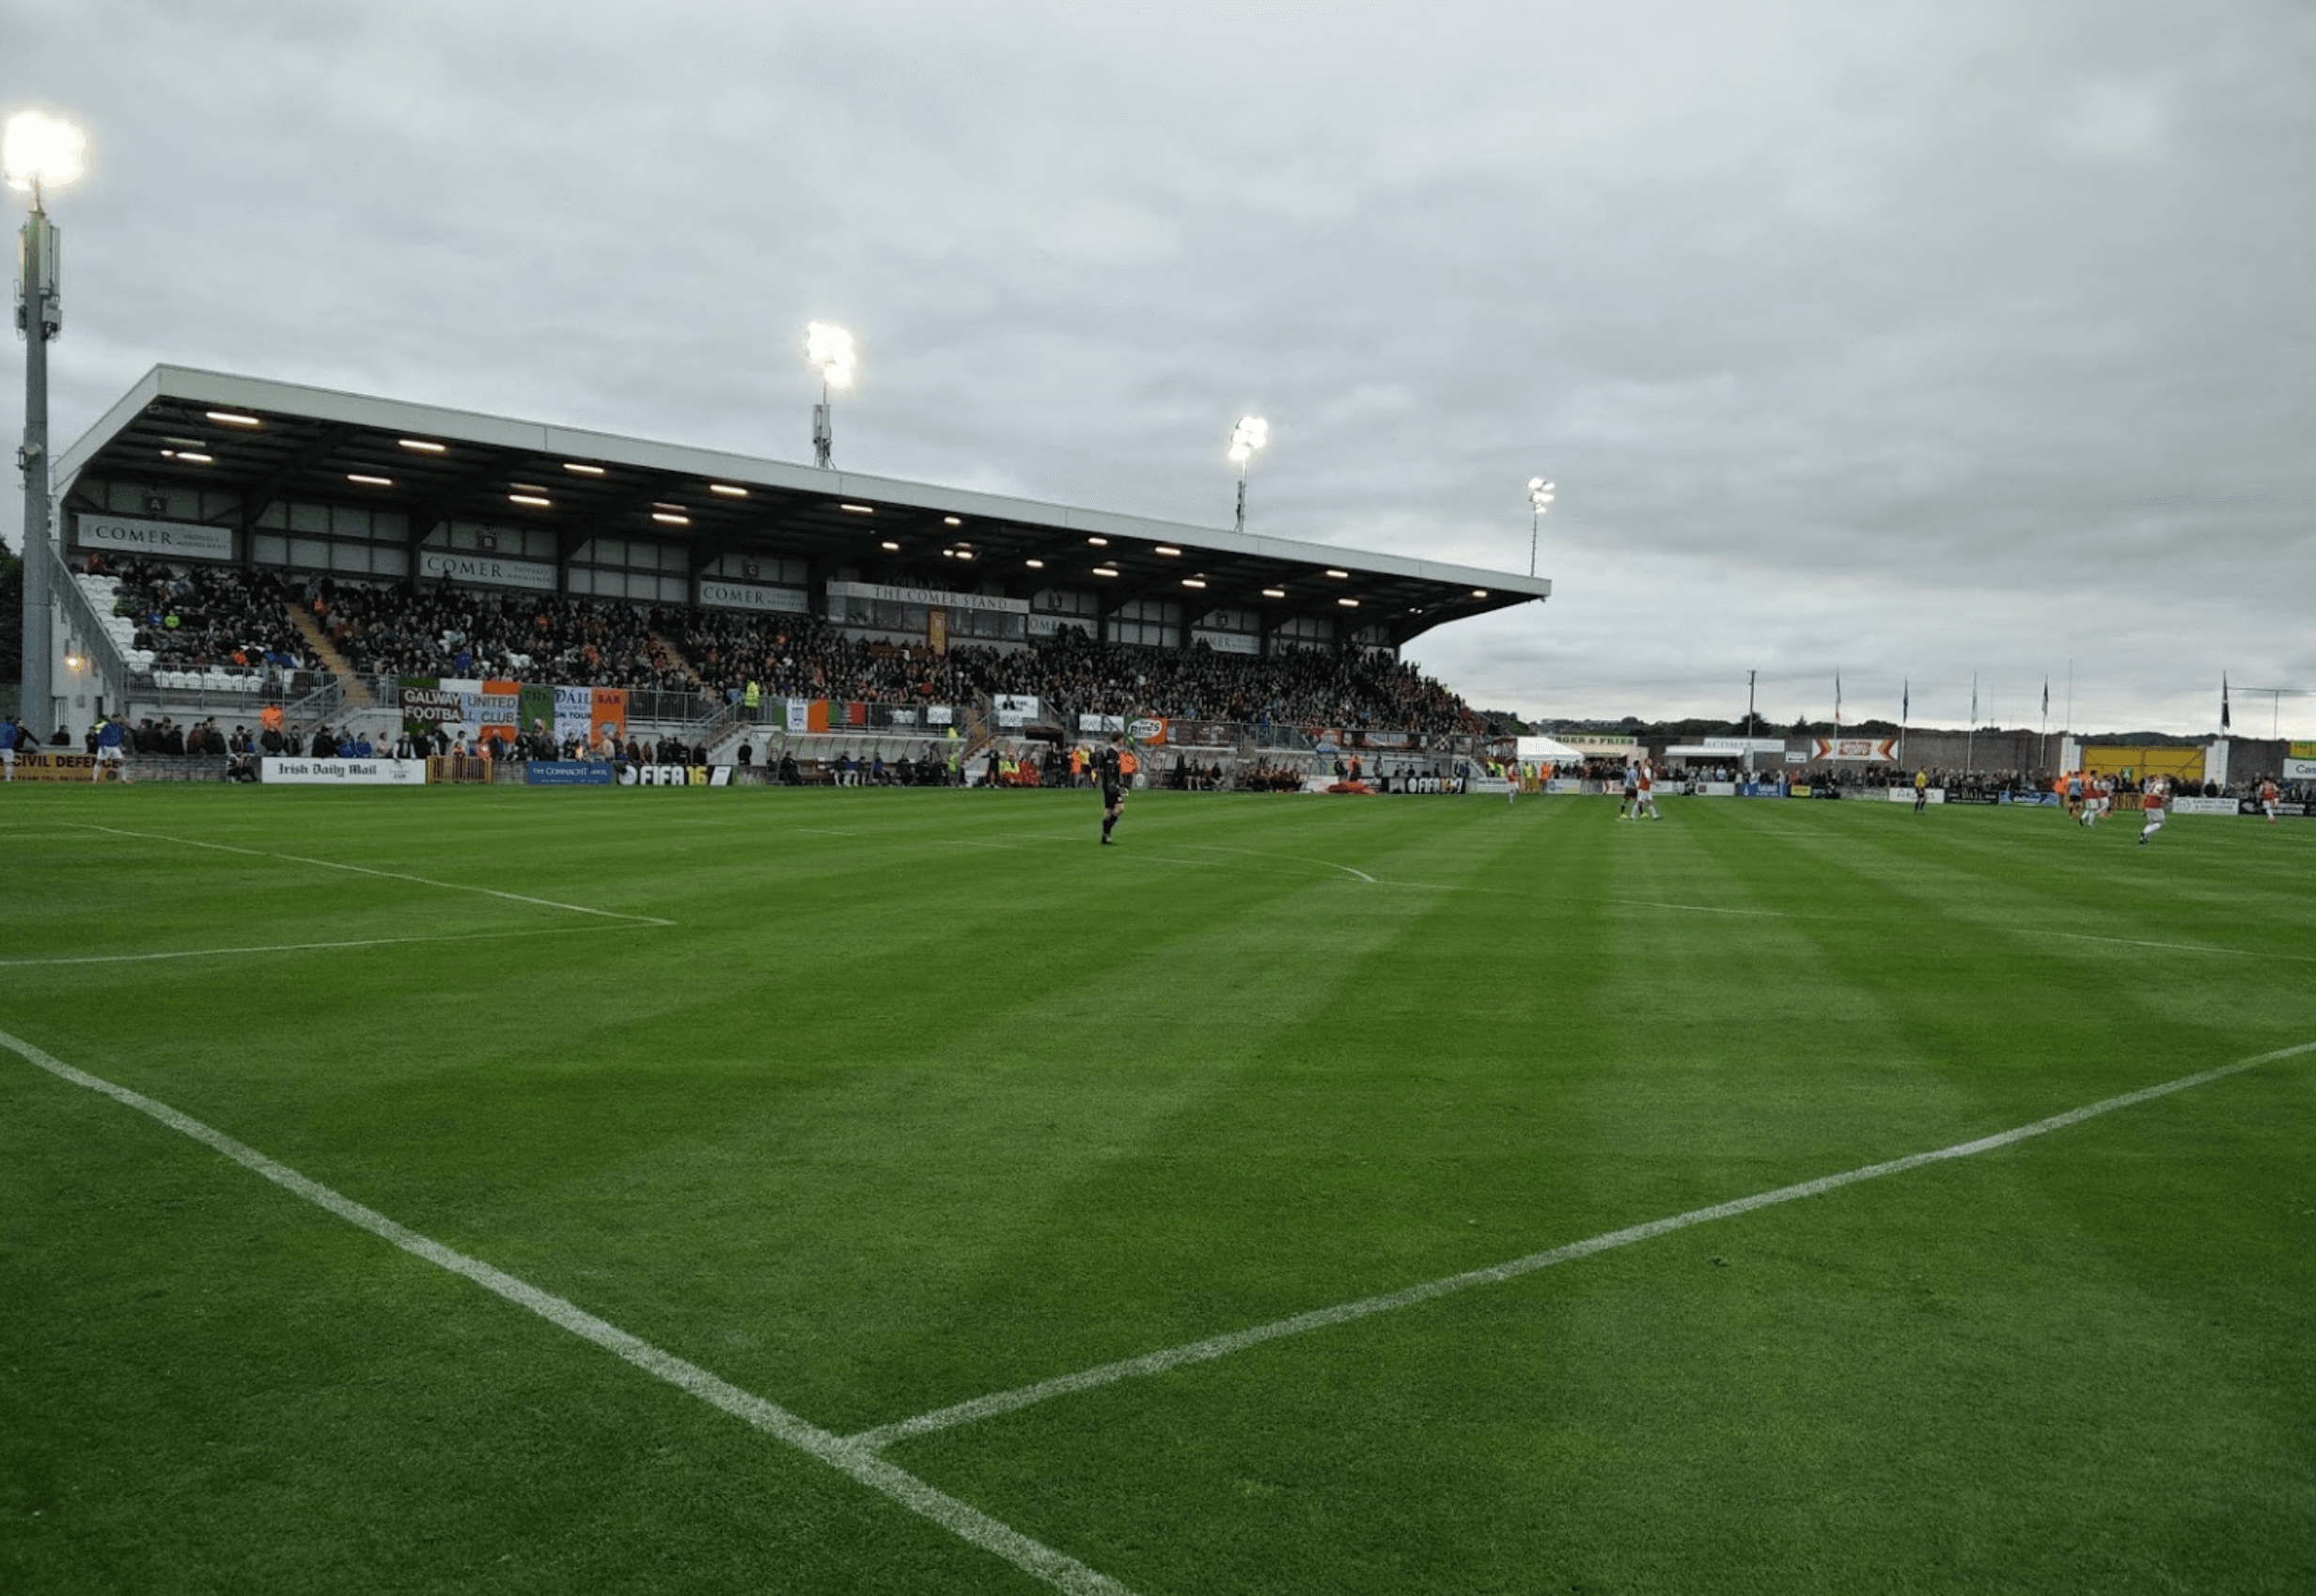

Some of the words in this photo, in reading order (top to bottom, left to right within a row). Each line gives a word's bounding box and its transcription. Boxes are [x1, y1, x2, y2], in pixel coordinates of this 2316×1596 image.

[96, 525, 172, 545] COMER
[427, 556, 503, 578] COMER
[703, 587, 765, 604] COMER
[874, 587, 901, 599] THE
[907, 589, 958, 605] COMER
[963, 595, 1007, 609] STAND
[404, 690, 461, 706] GALWAY
[467, 694, 516, 709] UNITED
[598, 694, 620, 704] BAR
[404, 706, 477, 723] FOOTBALL
[480, 711, 515, 723] CLUB
[12, 756, 52, 767] CIVIL
[278, 763, 308, 775] Irish
[313, 763, 345, 777] Daily
[349, 764, 376, 775] Mail
[640, 766, 685, 785] FIFA
[686, 766, 708, 785] 16
[1417, 778, 1440, 793] FIFA
